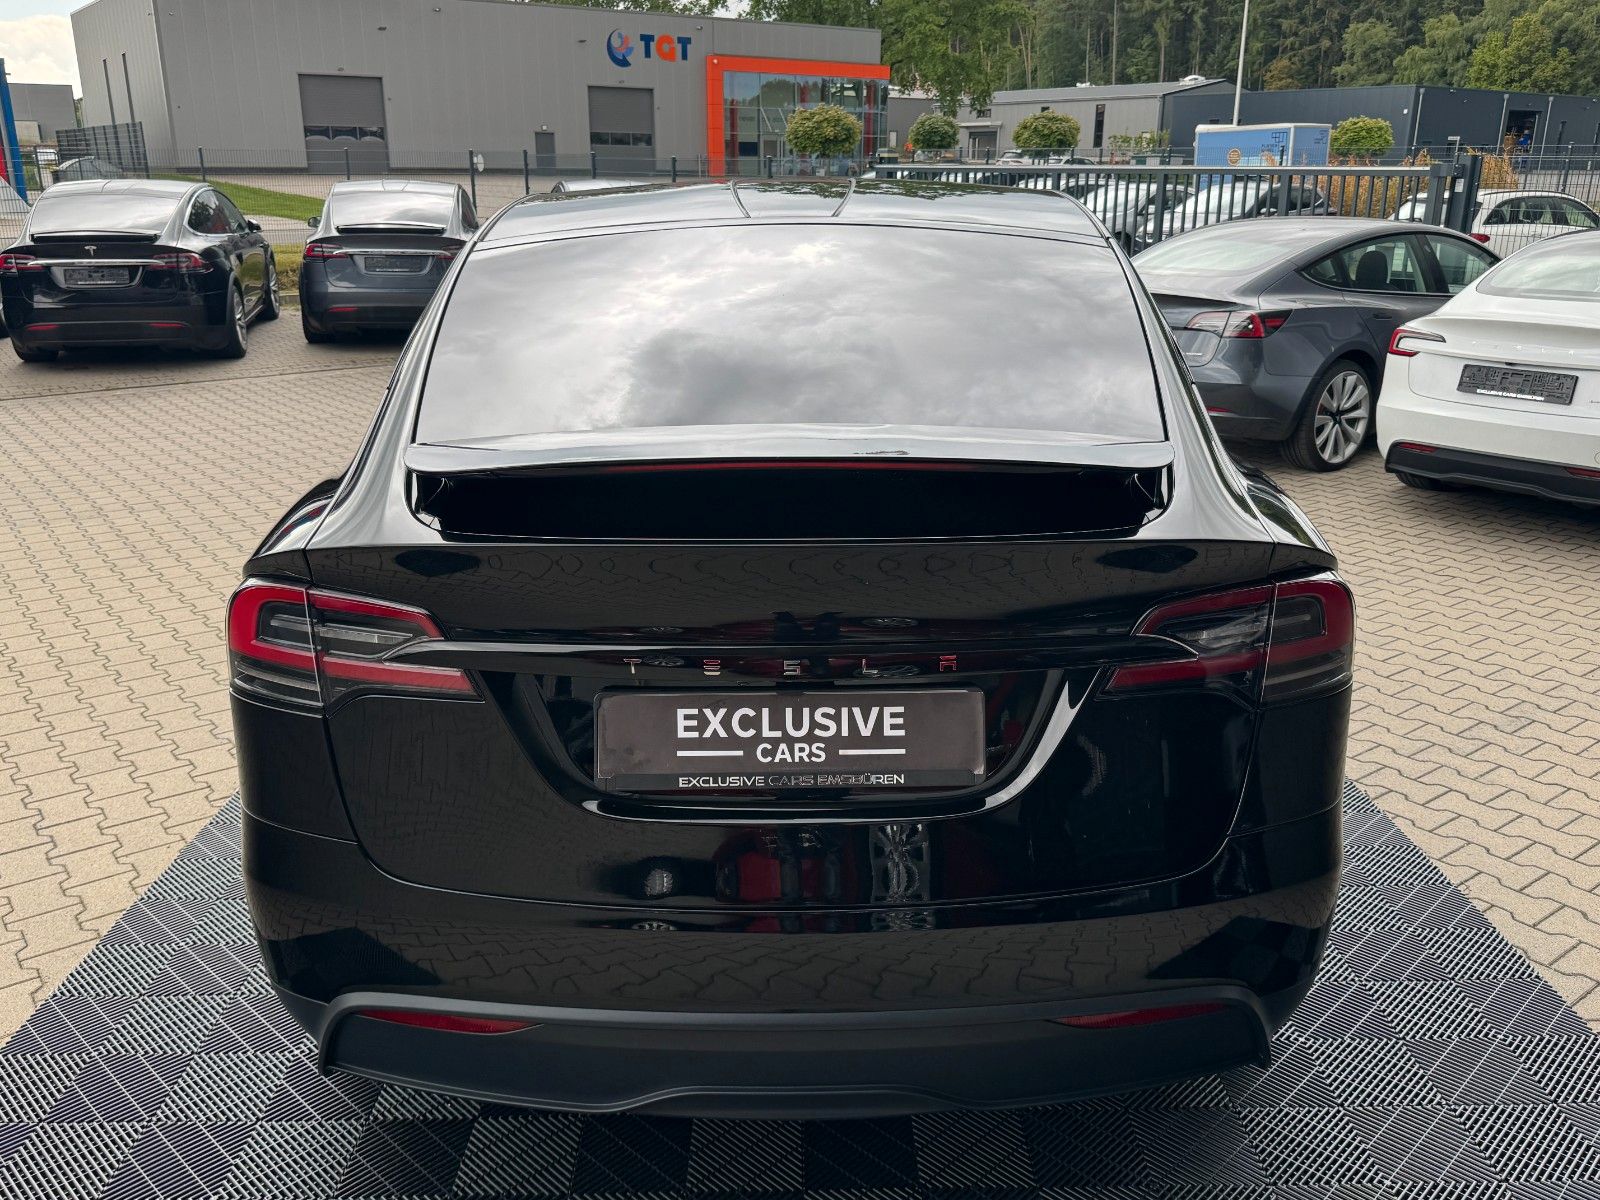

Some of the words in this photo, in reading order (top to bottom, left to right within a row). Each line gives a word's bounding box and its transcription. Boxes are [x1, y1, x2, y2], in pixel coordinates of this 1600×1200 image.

[640, 34, 692, 62] TGT
[623, 655, 957, 675] TESLA
[676, 706, 906, 738] EXCLUSIVE
[756, 743, 827, 763] CARS
[678, 776, 765, 788] EXCLUSIVE
[768, 775, 814, 786] CARS
[817, 772, 905, 786] EMSBÜREN
